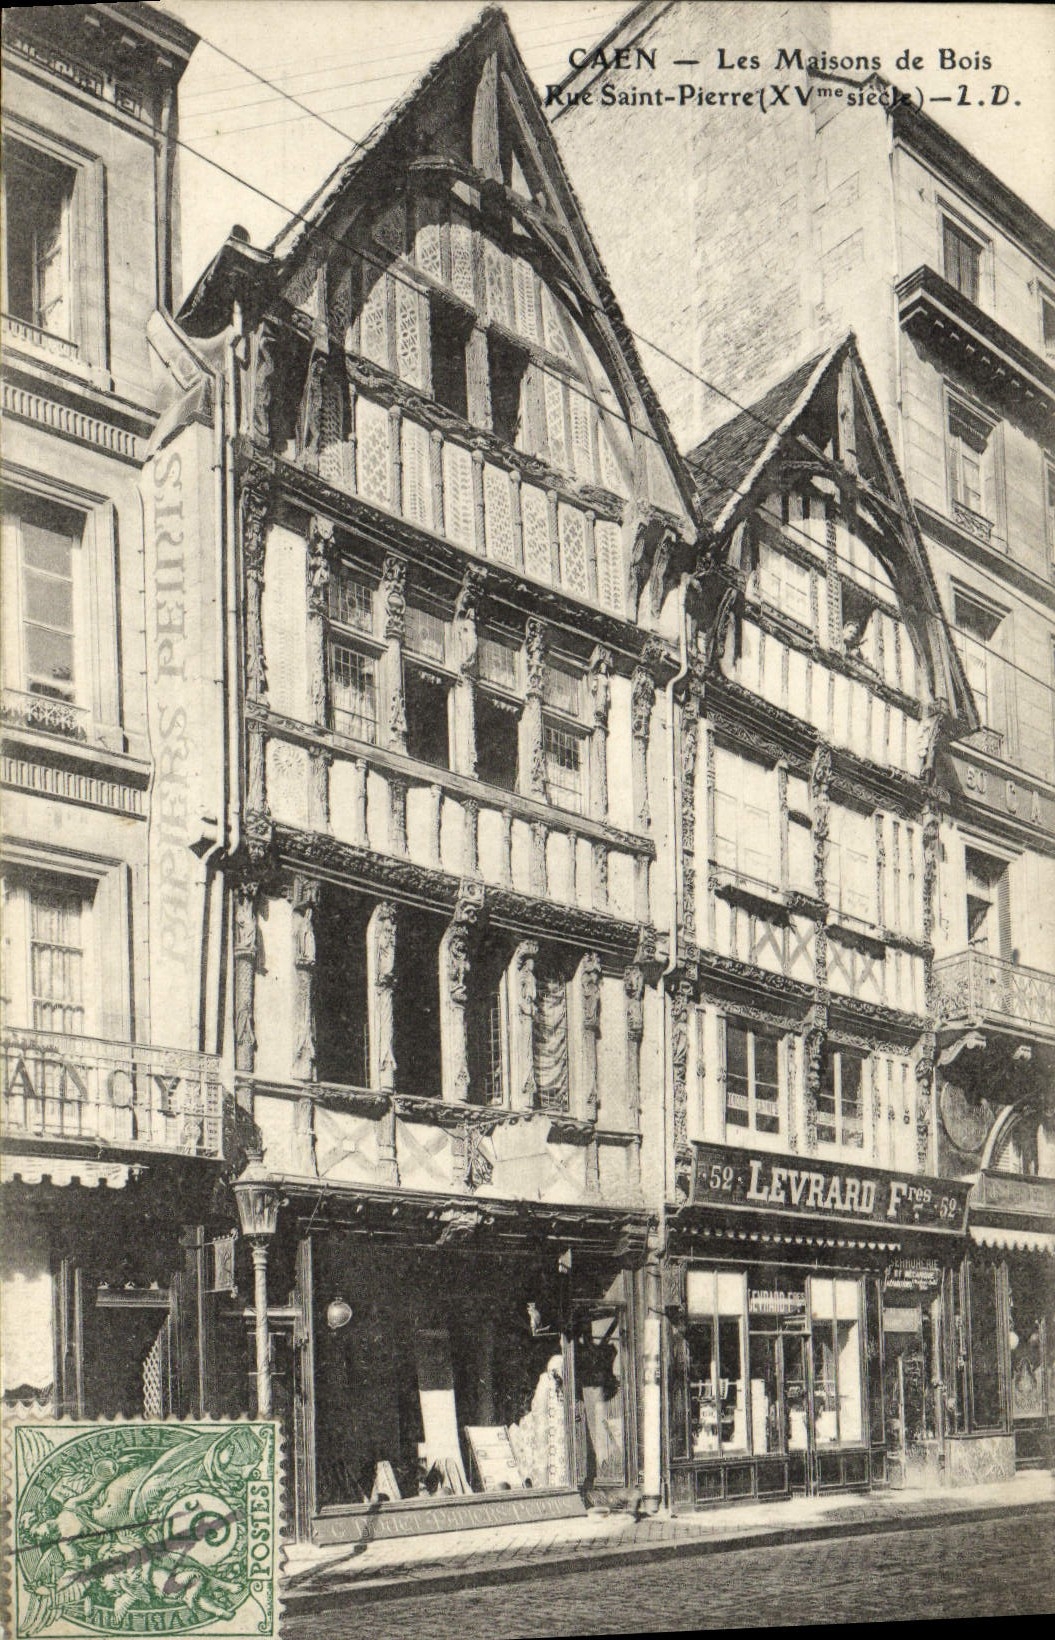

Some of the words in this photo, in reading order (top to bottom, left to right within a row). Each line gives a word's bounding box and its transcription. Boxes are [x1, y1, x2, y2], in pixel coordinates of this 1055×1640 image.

[709, 1165, 734, 1190] 52
[746, 1159, 876, 1213] LEVRARD
[940, 1196, 958, 1219] 52
[250, 1485, 270, 1577] POSTES
